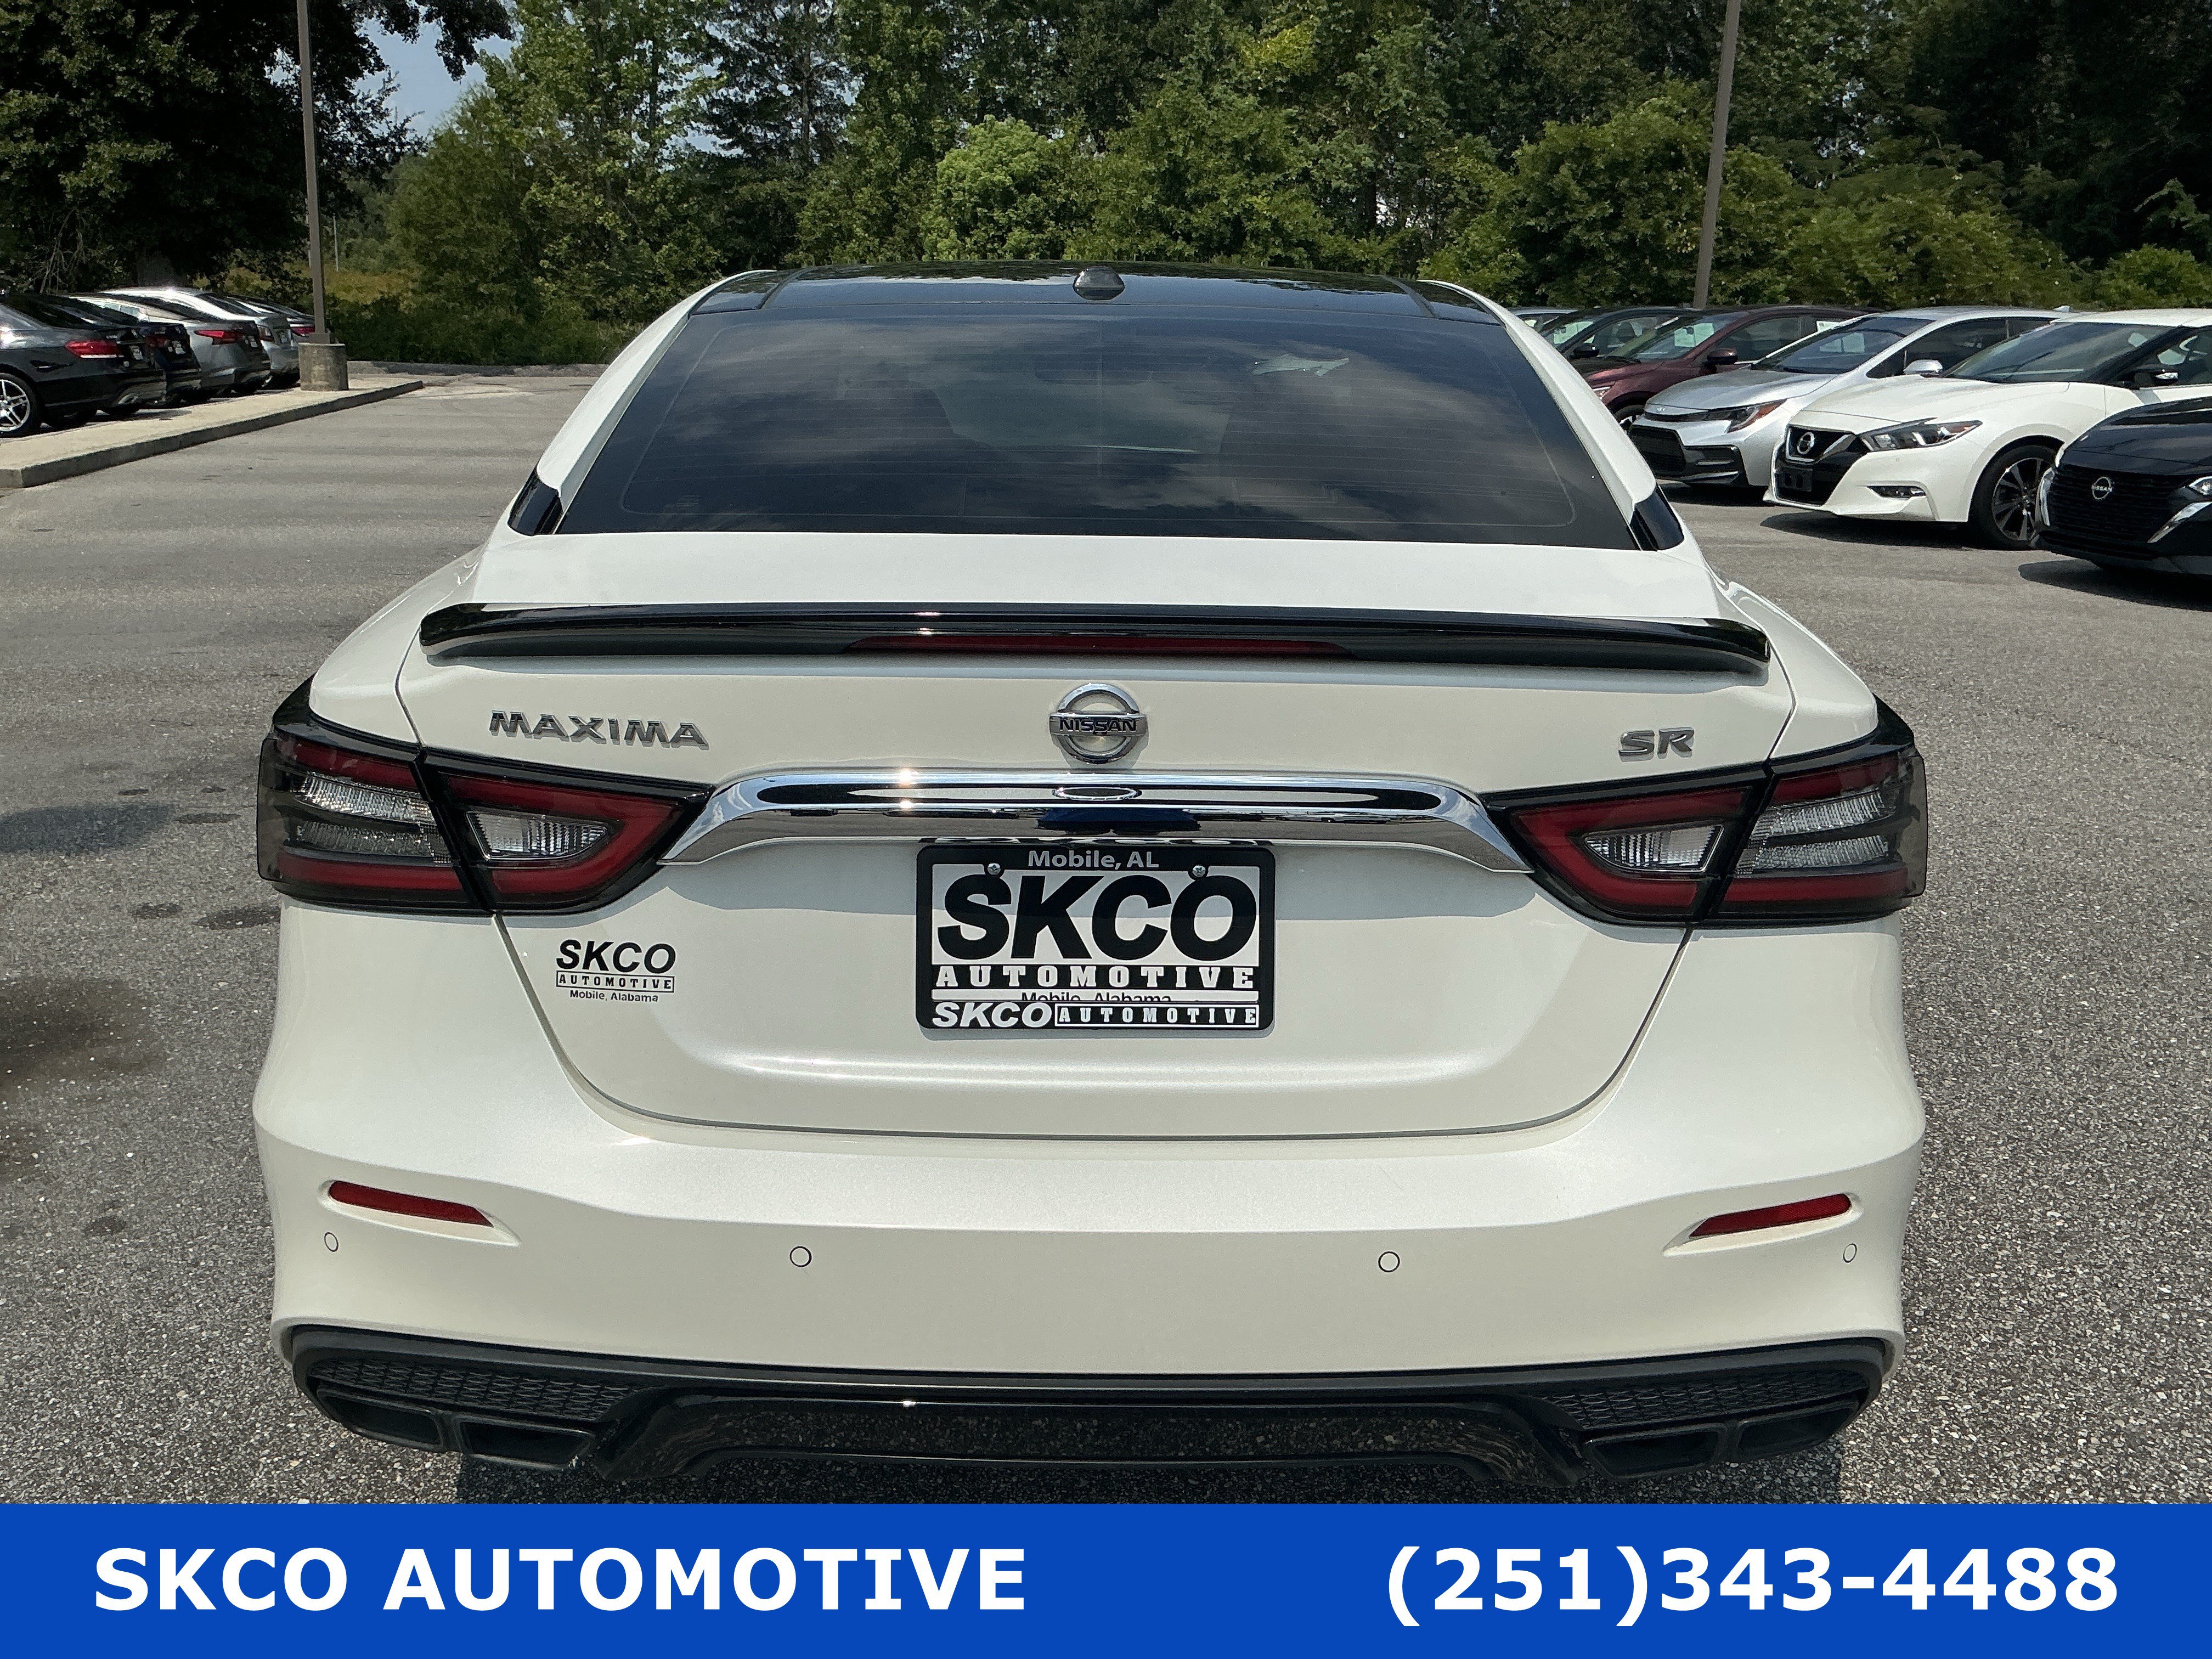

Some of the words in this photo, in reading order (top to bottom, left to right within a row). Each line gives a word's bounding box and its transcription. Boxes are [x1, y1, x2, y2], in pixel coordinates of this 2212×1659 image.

[489, 710, 709, 748] MAXIMA
[1059, 719, 1137, 732] NISSAN
[1618, 726, 1694, 759] SR
[1028, 850, 1121, 870] Mobile,
[1126, 851, 1159, 868] AL
[937, 873, 1257, 961] SKCO
[556, 939, 676, 974] SKCO
[559, 974, 672, 989] AUTOMOTIVE
[935, 966, 1254, 989] AUTOMOTIVE
[570, 990, 607, 1001] Mobile,
[610, 994, 658, 1002] Alabama
[932, 1002, 1052, 1028] SKCO
[1059, 1007, 1256, 1024] AUTOMOTIVE
